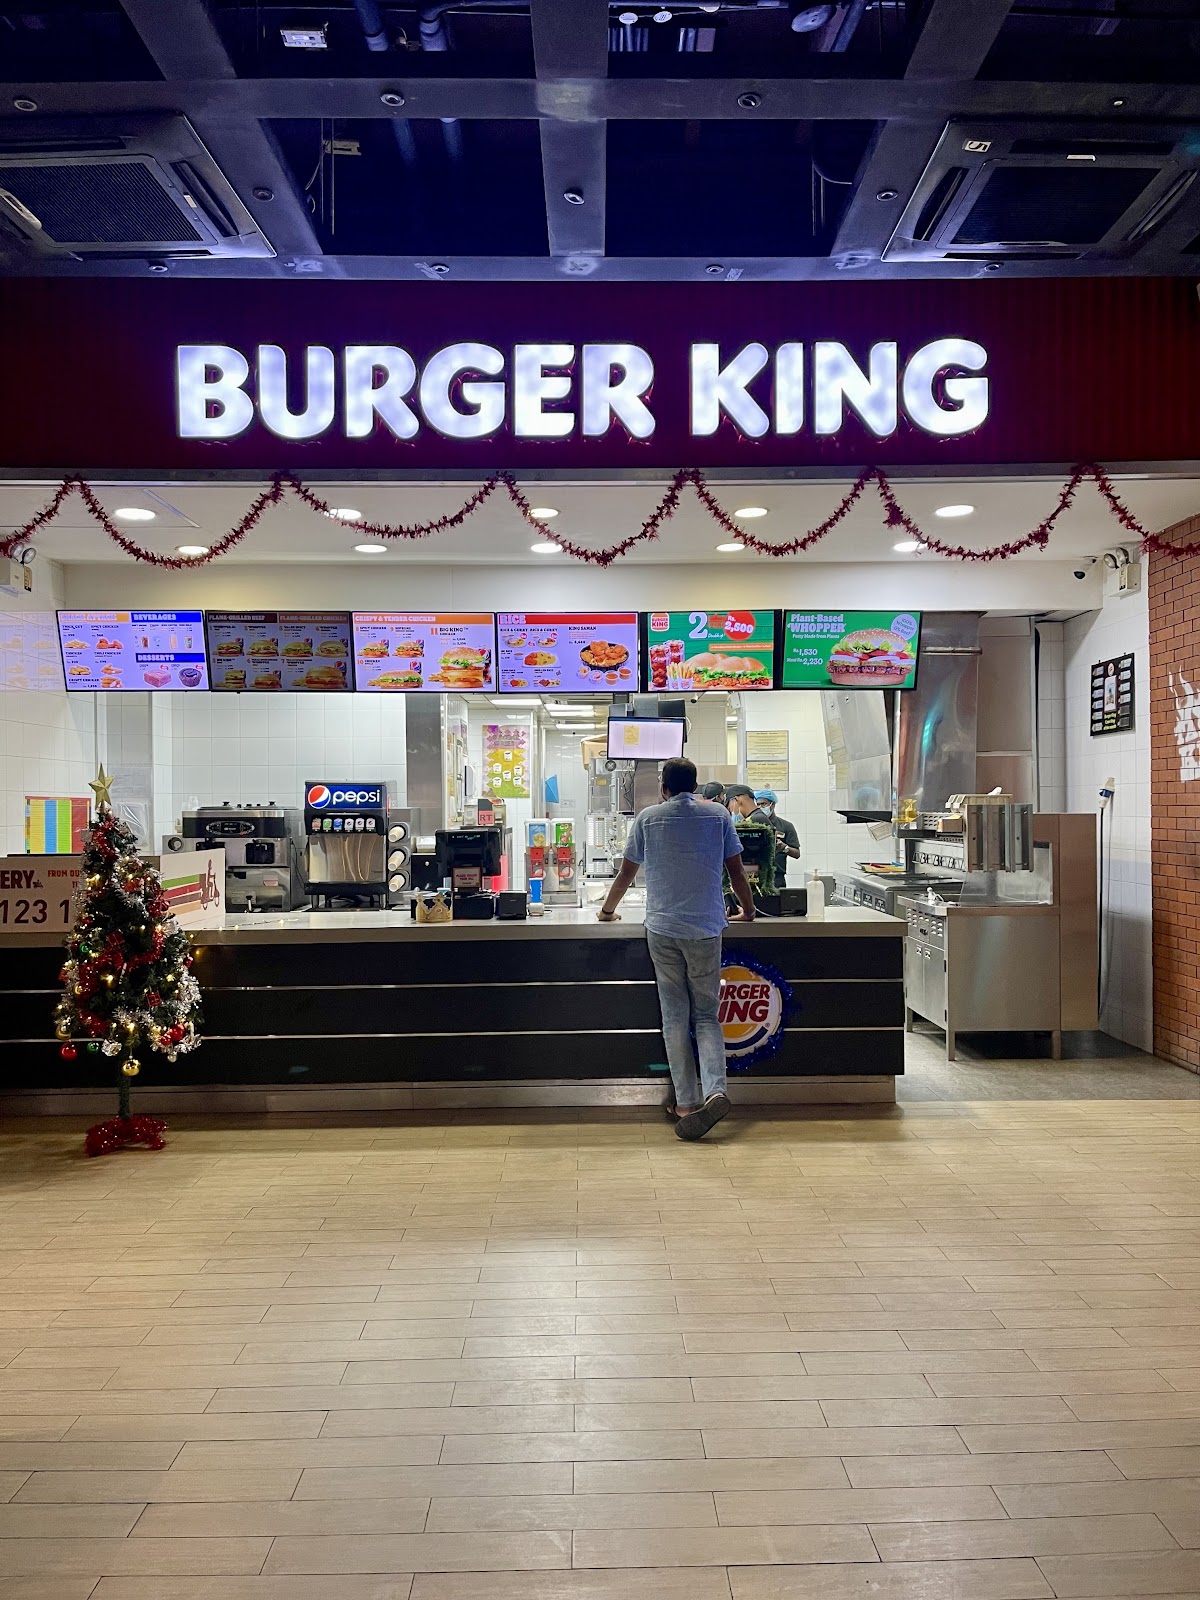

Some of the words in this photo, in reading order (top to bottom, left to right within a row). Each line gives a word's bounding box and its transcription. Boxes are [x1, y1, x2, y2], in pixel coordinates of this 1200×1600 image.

[177, 342, 656, 439] BURGER
[691, 338, 989, 438] KING
[133, 613, 177, 621] BEVERAGES
[500, 614, 526, 625] RICE
[791, 613, 844, 622] Plant-Based
[688, 611, 709, 639] 2
[724, 621, 754, 634] 2,500
[787, 623, 846, 633] WHOPPER
[137, 654, 175, 662] DESSERTS
[332, 789, 381, 805] pepsi
[480, 814, 493, 822] RT
[0, 869, 35, 889] ERY
[47, 869, 68, 877] FROM
[69, 869, 80, 877] OU
[718, 1001, 769, 1023] ING
